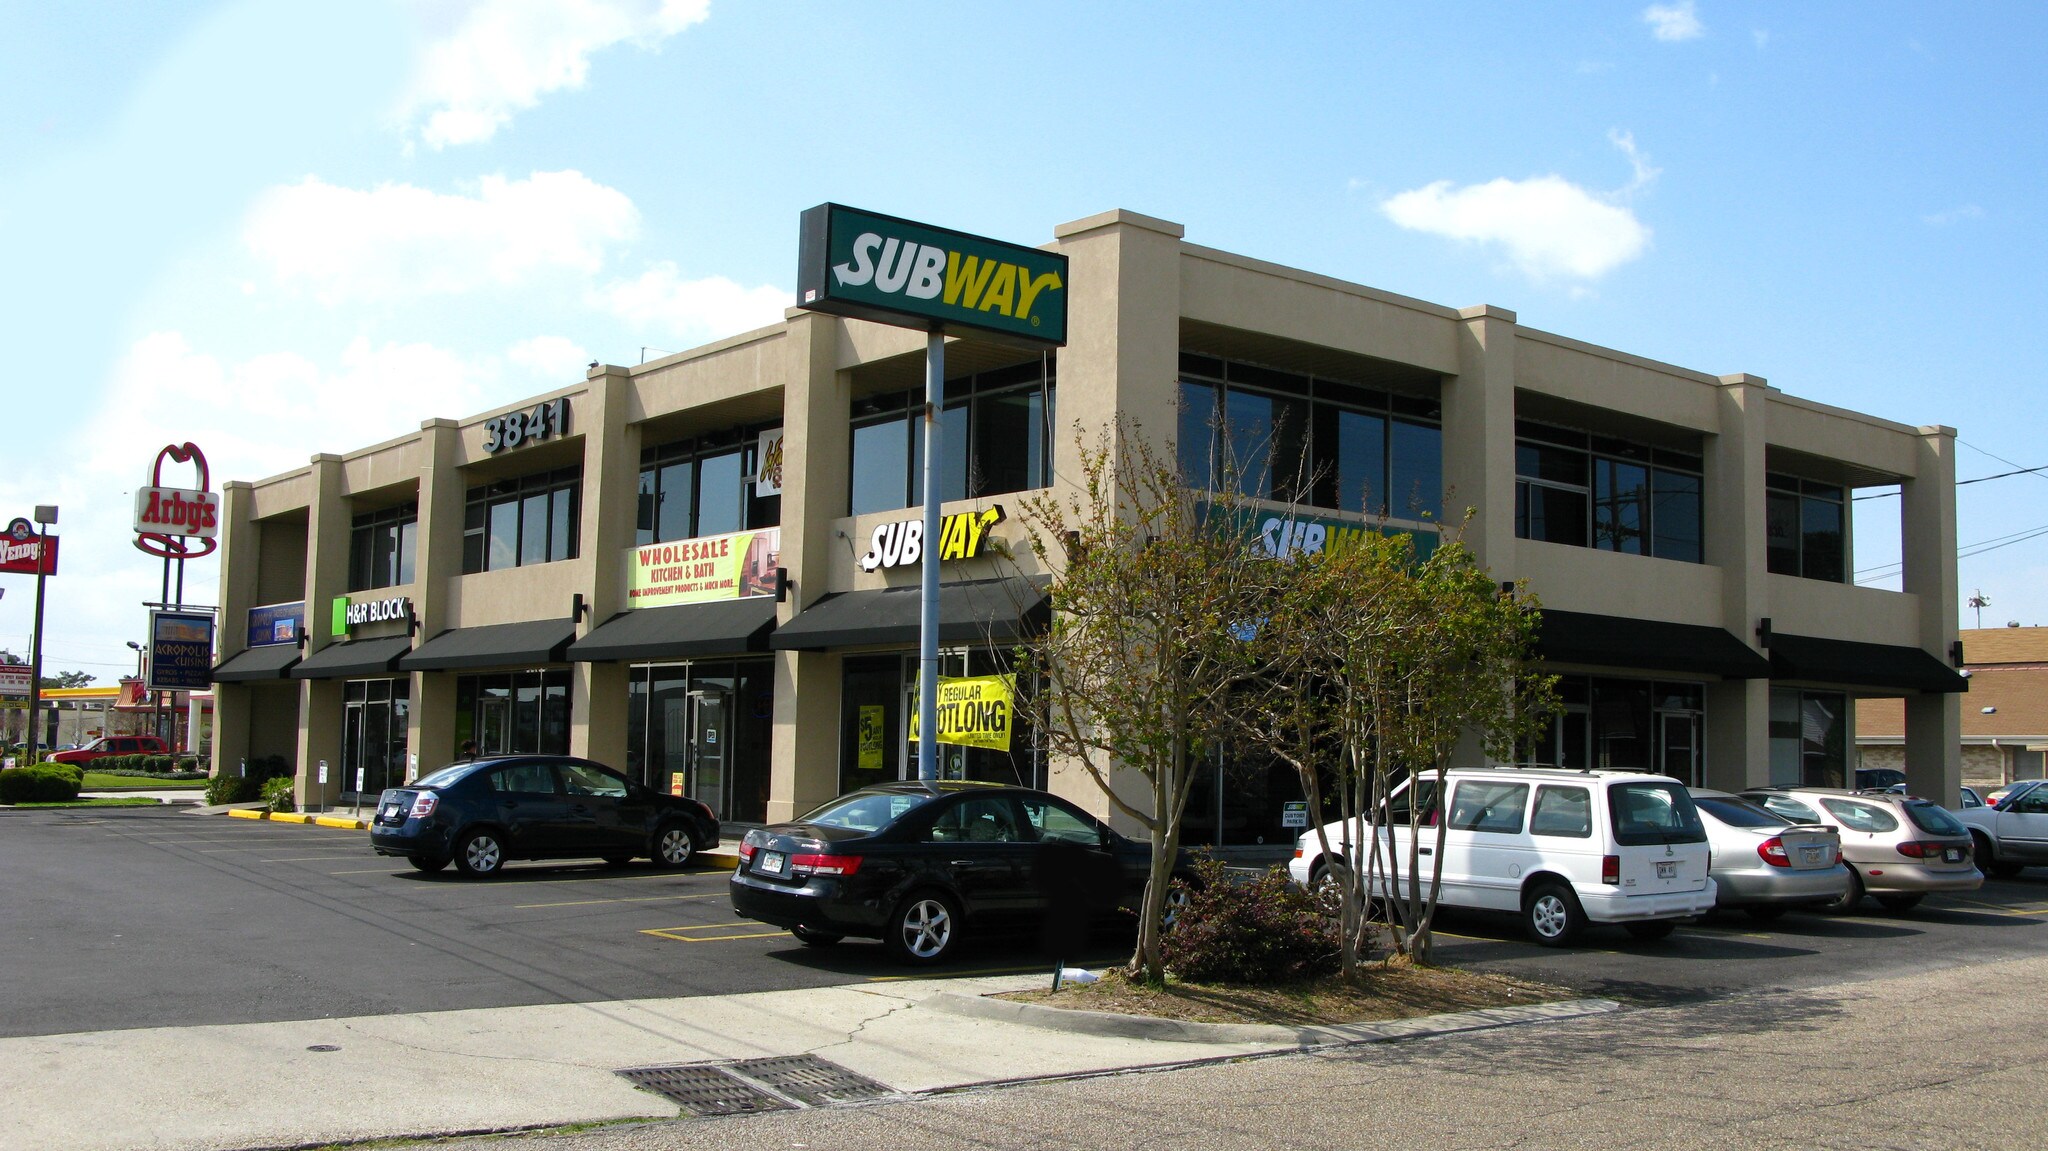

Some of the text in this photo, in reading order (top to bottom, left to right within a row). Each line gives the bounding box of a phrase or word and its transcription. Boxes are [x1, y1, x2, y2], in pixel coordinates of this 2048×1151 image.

[832, 232, 1062, 320] SUBWAY
[482, 397, 569, 453] 3841
[142, 491, 216, 534] Arby's
[639, 538, 729, 567] WHOLESALE
[651, 562, 715, 583] KITCHEN & BATH
[629, 588, 642, 598] HOME
[642, 587, 674, 597] IMPROVEMENT
[675, 583, 699, 593] PRODUCTS
[704, 580, 719, 590] MUCH
[346, 597, 405, 625] H&R BLOCK
[155, 644, 209, 657] ACROPOLIS
[175, 657, 209, 667] CUISINE
[944, 685, 981, 702] REGULAR
[937, 700, 1005, 735] OTLONG
